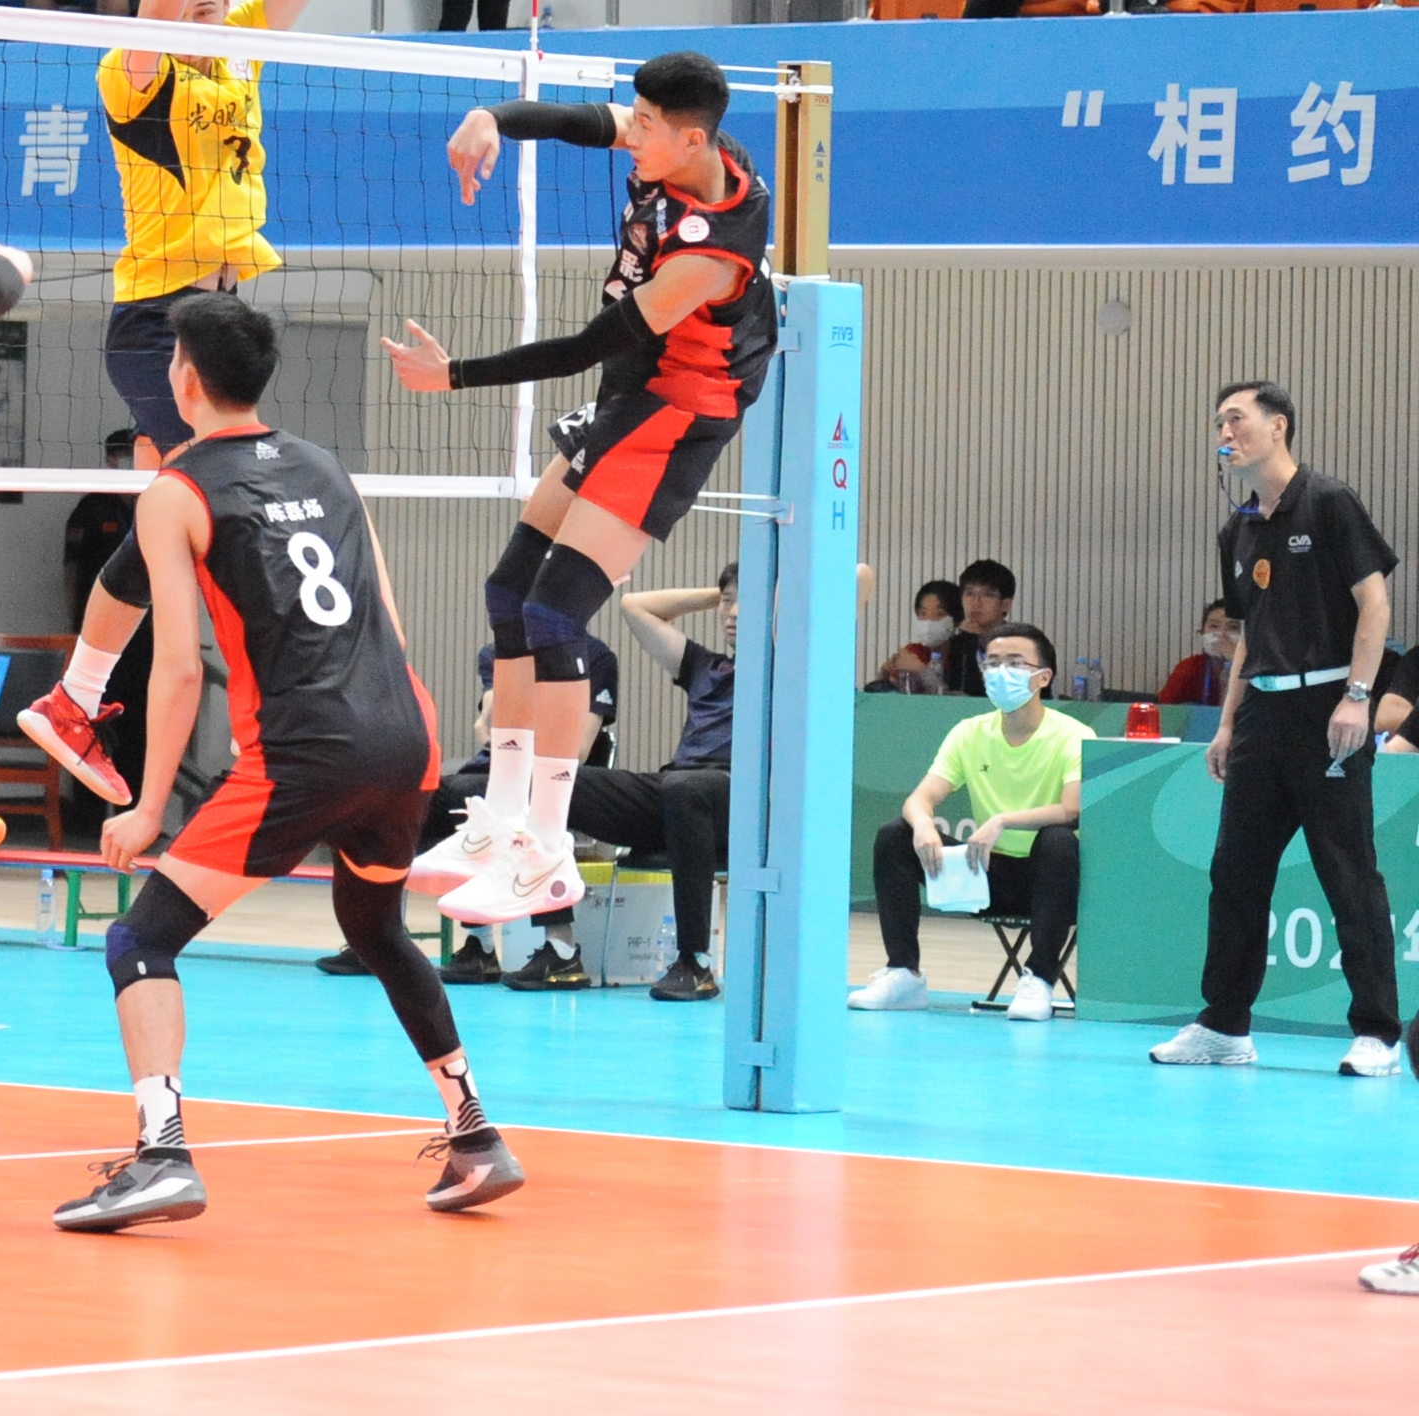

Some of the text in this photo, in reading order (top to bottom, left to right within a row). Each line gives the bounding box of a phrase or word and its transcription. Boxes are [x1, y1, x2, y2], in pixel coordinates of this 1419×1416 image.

[831, 325, 855, 342] FIVB
[1288, 534, 1312, 547] CVA
[287, 531, 353, 627] 8
